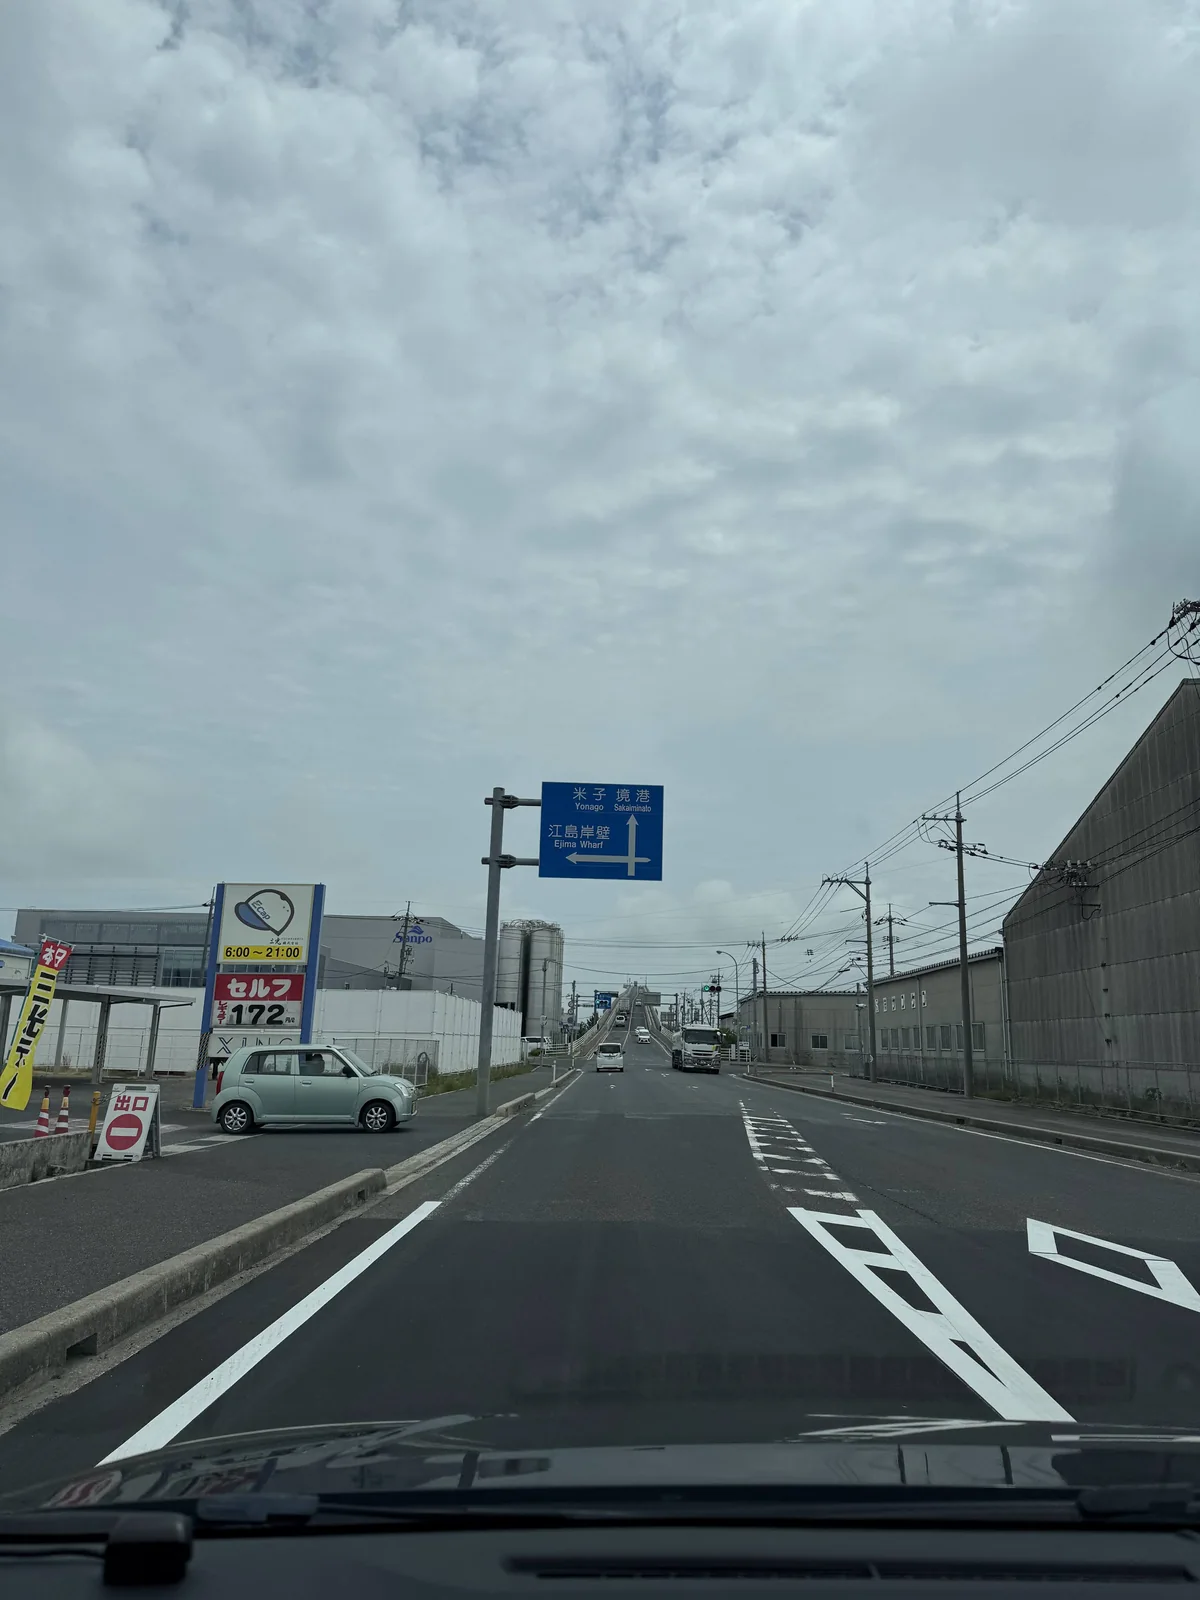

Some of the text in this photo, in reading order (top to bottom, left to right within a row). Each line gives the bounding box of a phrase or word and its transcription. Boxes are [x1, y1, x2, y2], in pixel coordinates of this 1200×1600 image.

[573, 787, 650, 803] 米子 境港
[575, 803, 652, 813] Yonago Sakaiminato
[548, 824, 610, 840] 江島岸壁
[554, 840, 604, 849] Ejima Wharf
[227, 977, 292, 998] セルフ
[231, 1004, 285, 1025] 172
[113, 1095, 150, 1112] 出口
